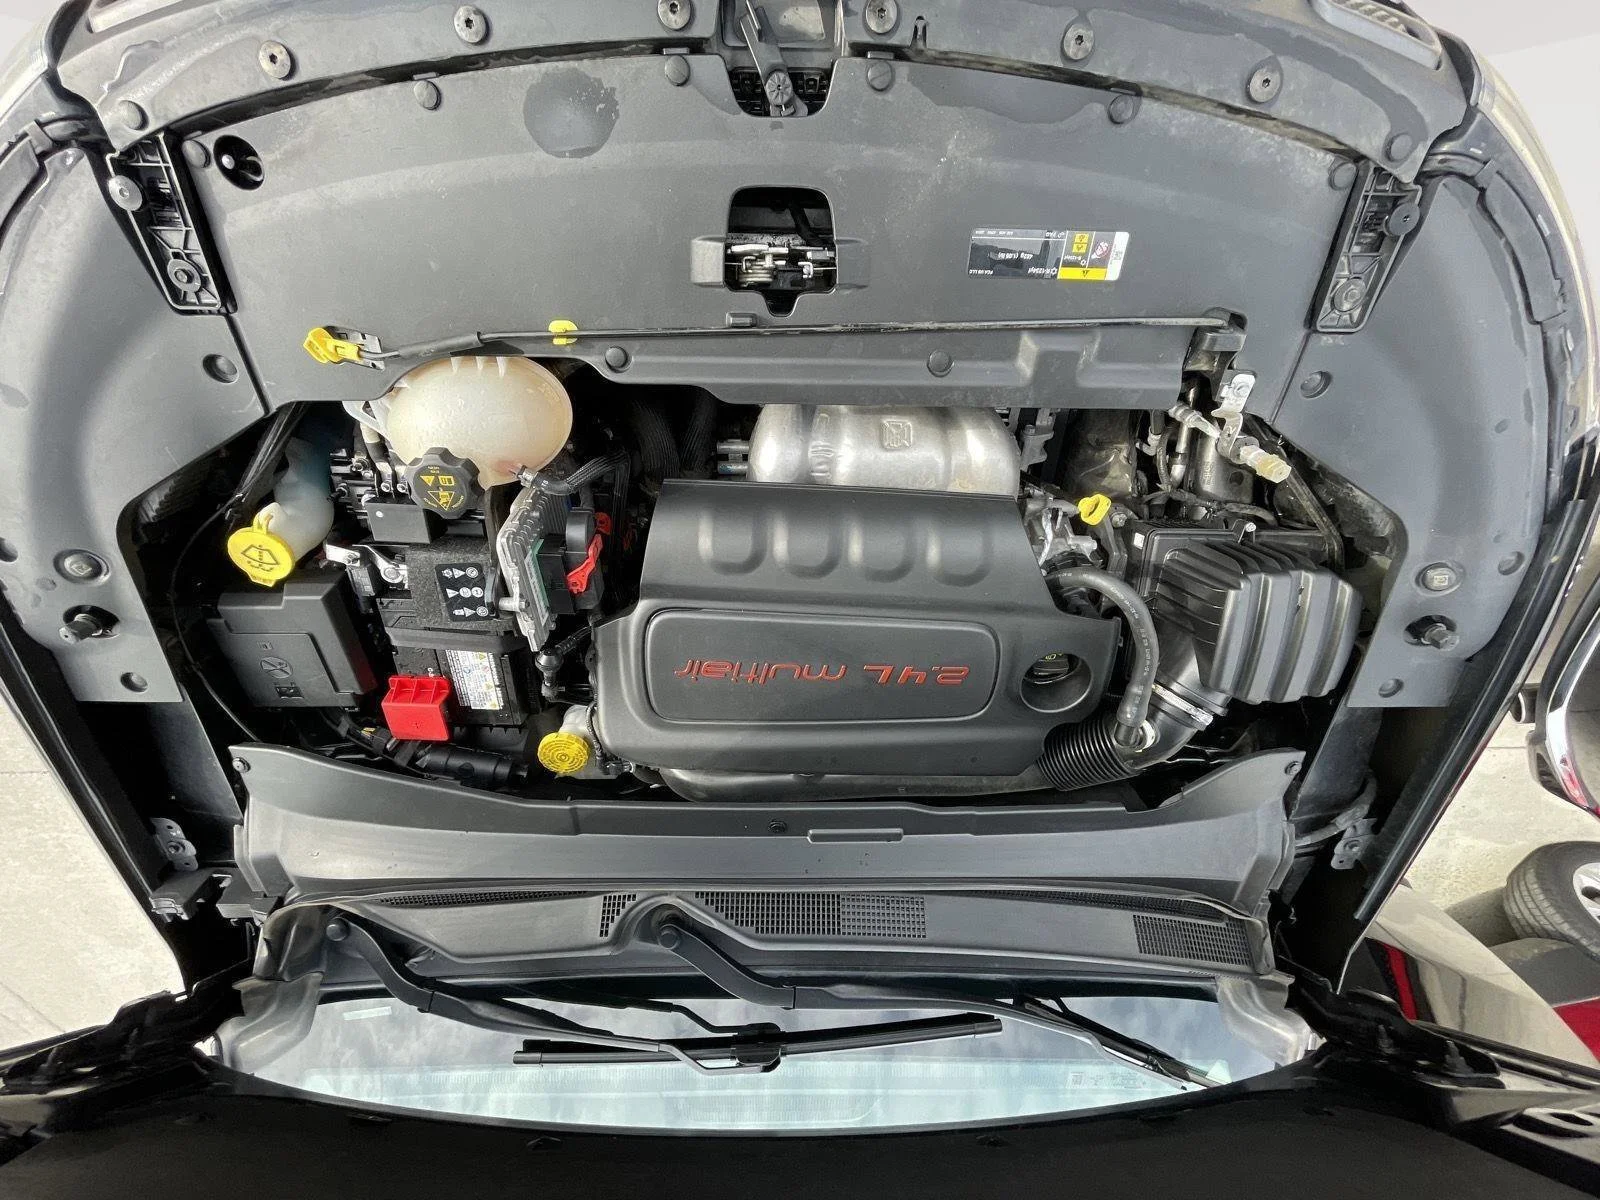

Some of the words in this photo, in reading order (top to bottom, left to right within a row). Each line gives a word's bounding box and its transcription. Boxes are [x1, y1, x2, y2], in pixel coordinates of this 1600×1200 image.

[1027, 266, 1051, 275] R-1234yf
[673, 658, 848, 685] multiair
[863, 664, 970, 686] 2.4L
